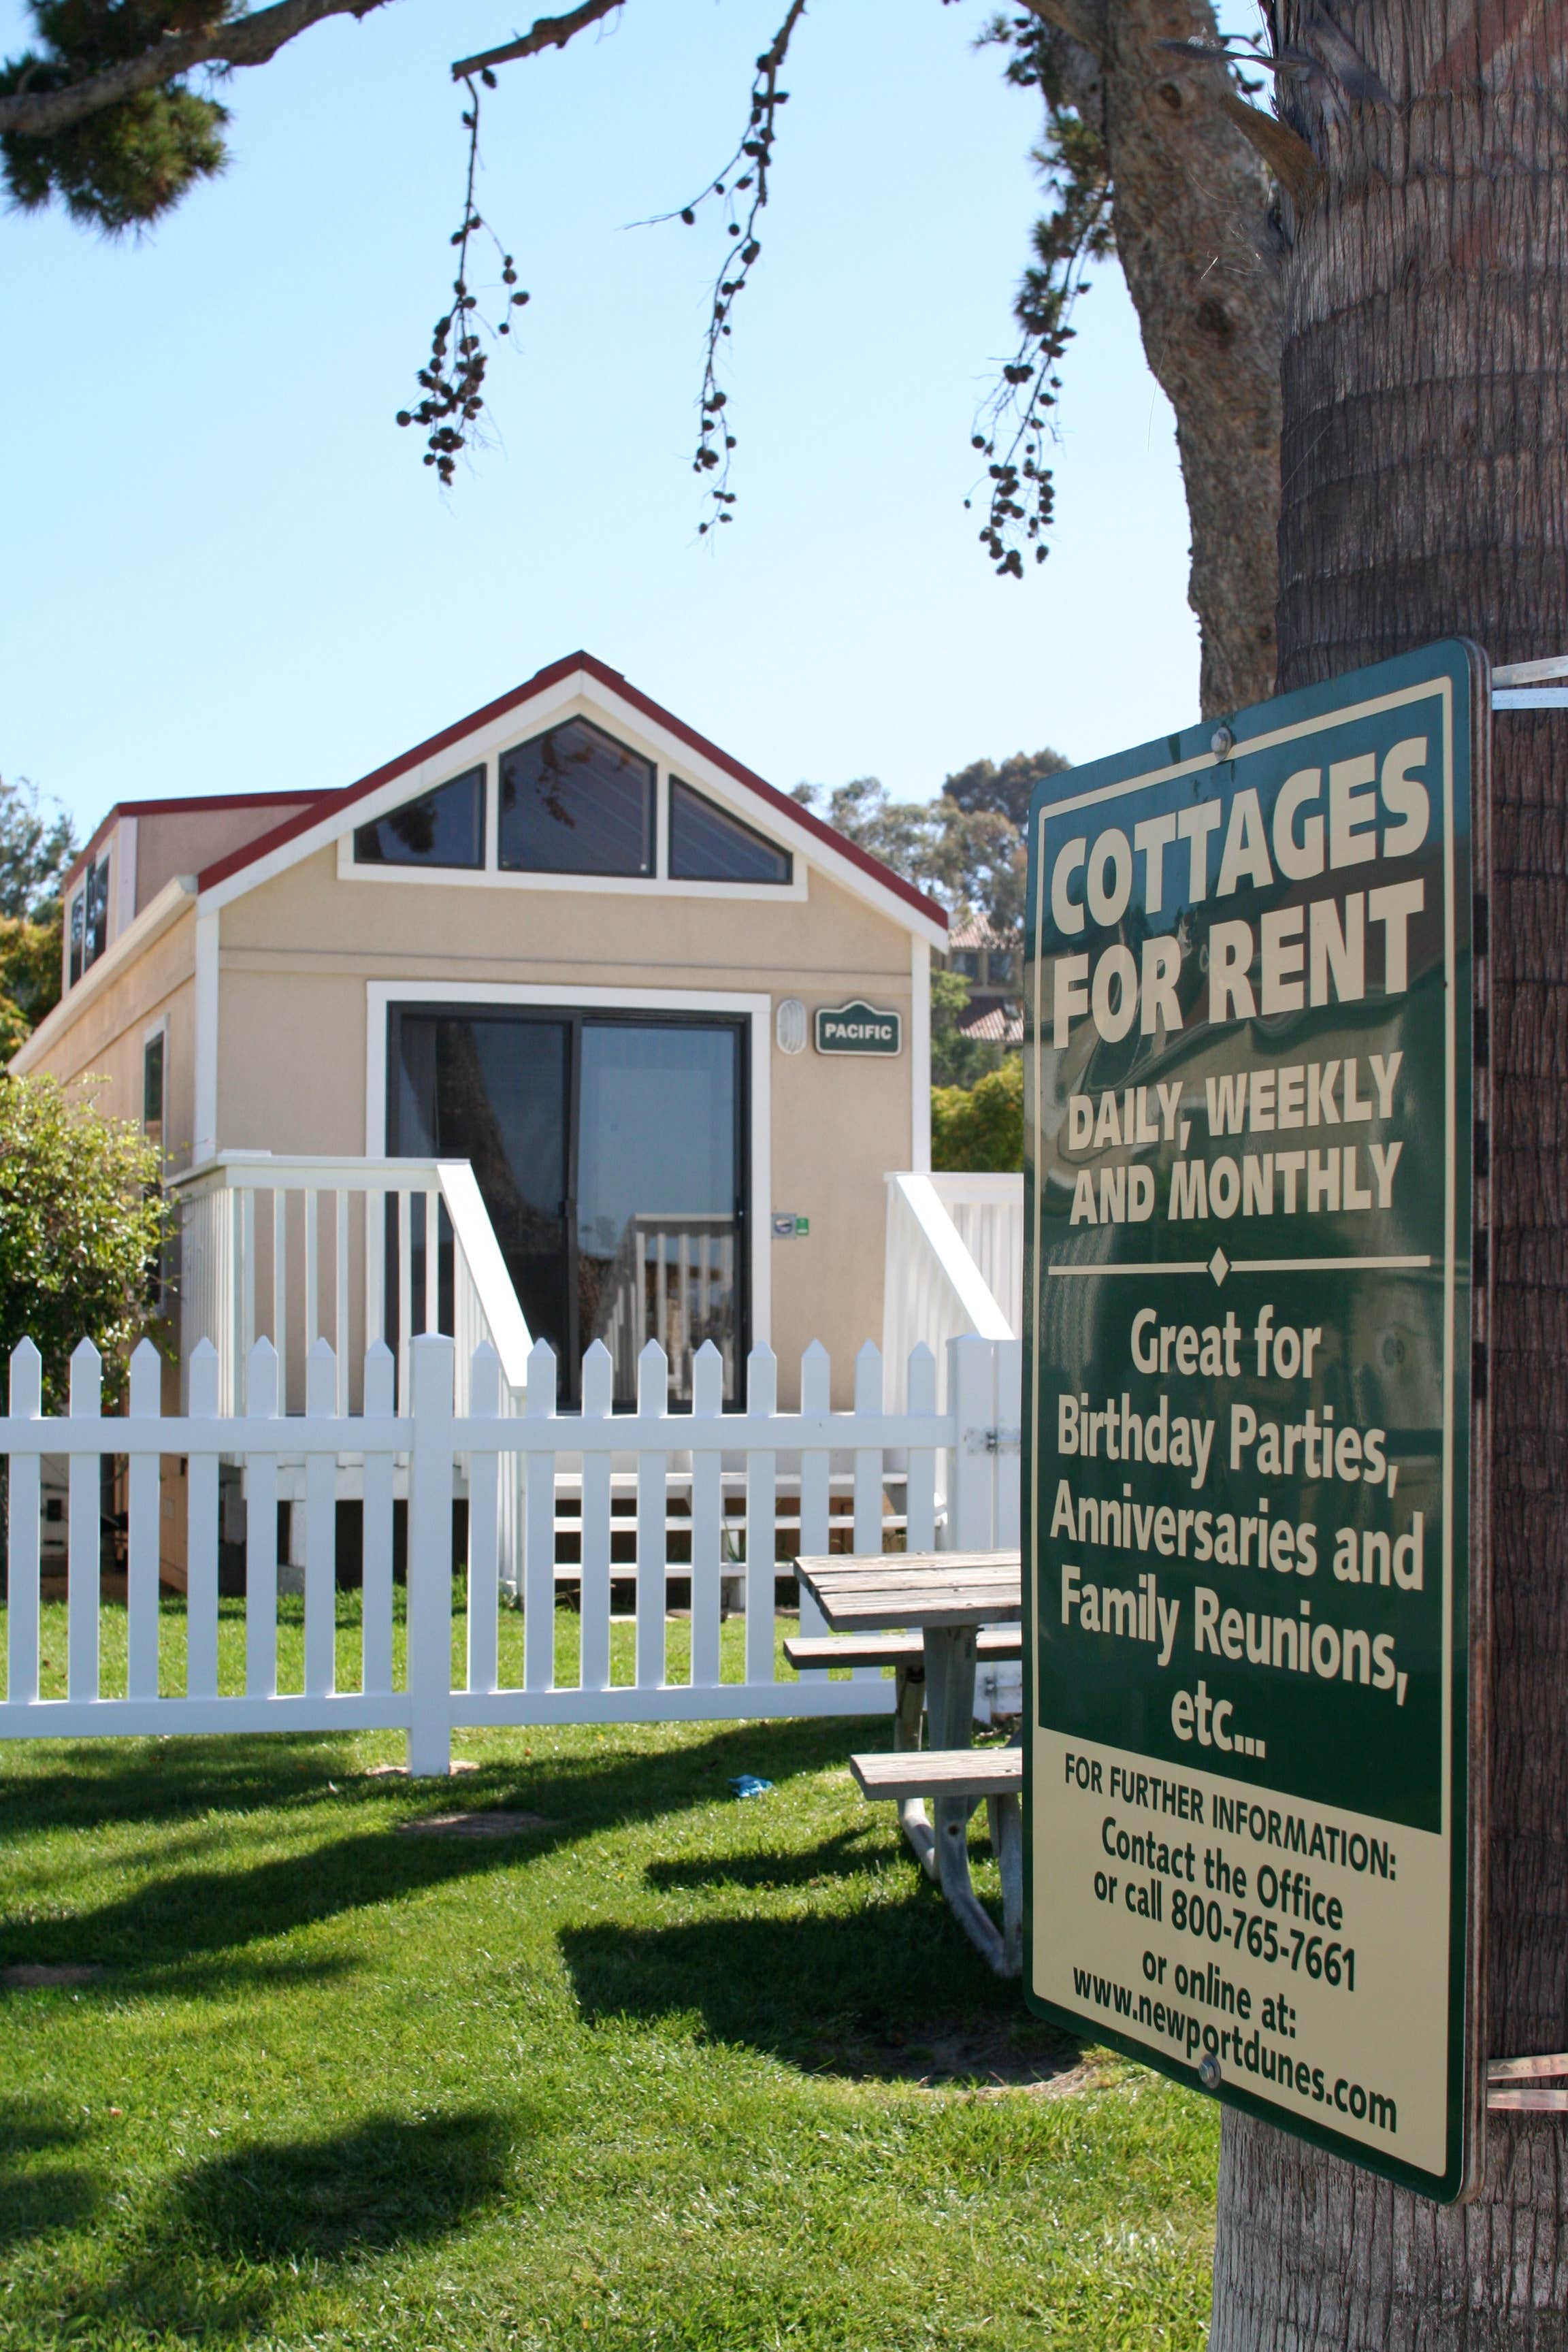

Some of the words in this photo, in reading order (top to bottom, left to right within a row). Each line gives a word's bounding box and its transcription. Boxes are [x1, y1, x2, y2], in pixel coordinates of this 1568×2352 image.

[1051, 736, 1430, 934] COTTAGES
[1054, 935, 1184, 1049] FOR
[1209, 879, 1425, 1024] RENT
[825, 1023, 892, 1040] PACIFIC
[1068, 1081, 1191, 1152] DAILY,
[1206, 1051, 1403, 1136] WEEKLY
[1070, 1164, 1155, 1225] AND
[1168, 1142, 1403, 1220] MONTHLY
[1131, 1308, 1241, 1377] Great
[1254, 1305, 1322, 1379] for
[1058, 1393, 1215, 1490] Birthday
[1230, 1403, 1399, 1498] Parties,
[1050, 1480, 1318, 1576] Anniversaries
[1333, 1512, 1424, 1590] and
[1062, 1564, 1179, 1667] Family
[1194, 1586, 1408, 1706] Reunions,
[1171, 1680, 1266, 1758] etc...
[1065, 1753, 1102, 1794] FOR
[1111, 1766, 1204, 1824] FURTHER
[1213, 1794, 1396, 1881] INFORMATION:
[1102, 1816, 1195, 1882] Contact
[1204, 1848, 1247, 1898] the
[1257, 1865, 1342, 1931] Office
[1094, 1871, 1117, 1904] or
[1126, 1879, 1162, 1923] call
[1171, 1889, 1356, 1991] 800-765-7661
[1143, 1950, 1166, 1985] or
[1175, 1962, 1252, 2019] online
[1262, 1993, 1296, 2039] at:
[1073, 1966, 1397, 2134] www.newportdunes.com
